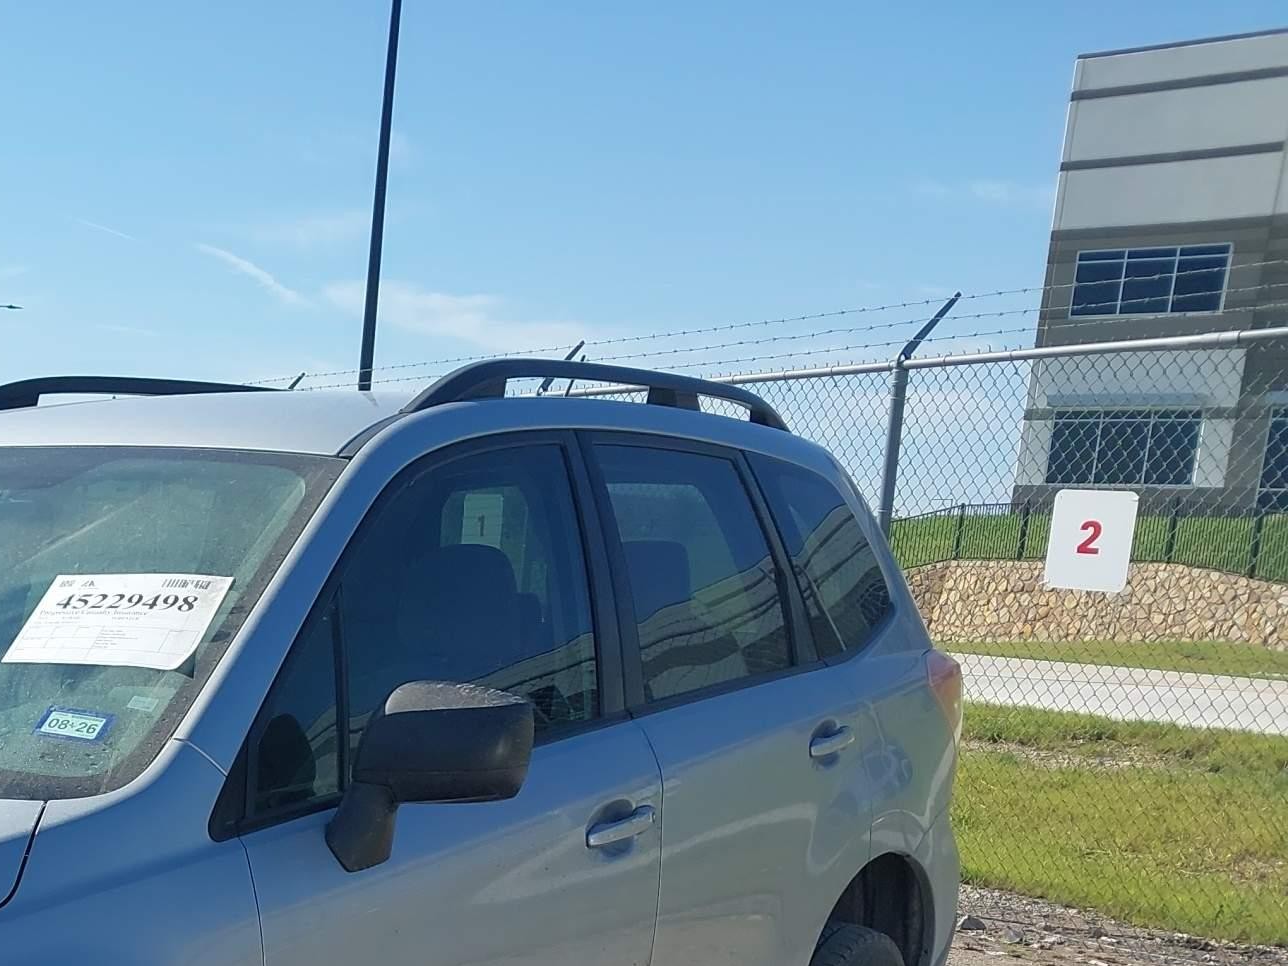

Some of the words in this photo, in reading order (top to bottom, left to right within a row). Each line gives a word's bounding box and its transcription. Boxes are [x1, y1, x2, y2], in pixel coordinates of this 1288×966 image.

[478, 515, 486, 537] 1
[1076, 520, 1103, 555] 2
[56, 593, 199, 613] 45229498
[75, 722, 98, 734] 26
